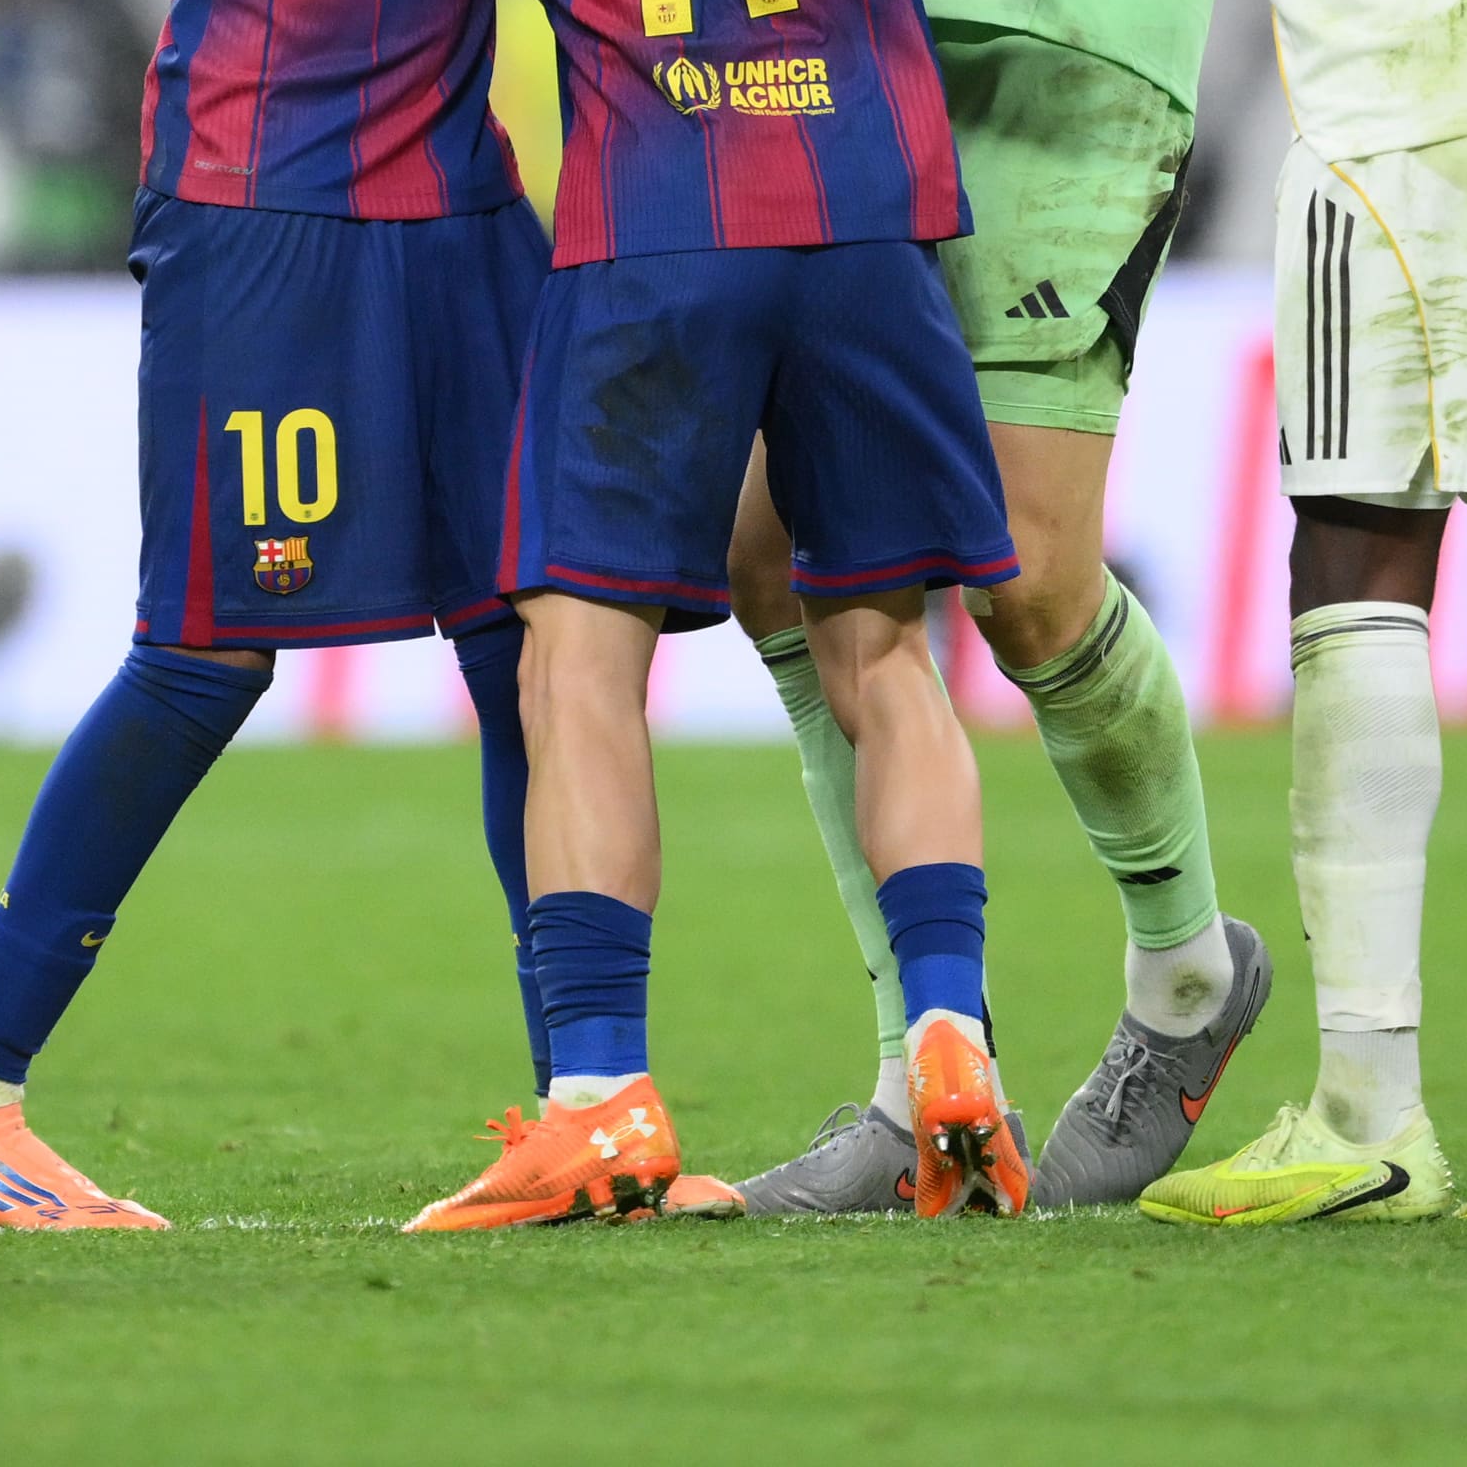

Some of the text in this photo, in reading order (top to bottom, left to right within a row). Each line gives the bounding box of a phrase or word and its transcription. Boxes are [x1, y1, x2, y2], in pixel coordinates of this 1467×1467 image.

[725, 58, 828, 85] UNHCR
[730, 83, 834, 109] ACNUR
[224, 408, 338, 526] 10
